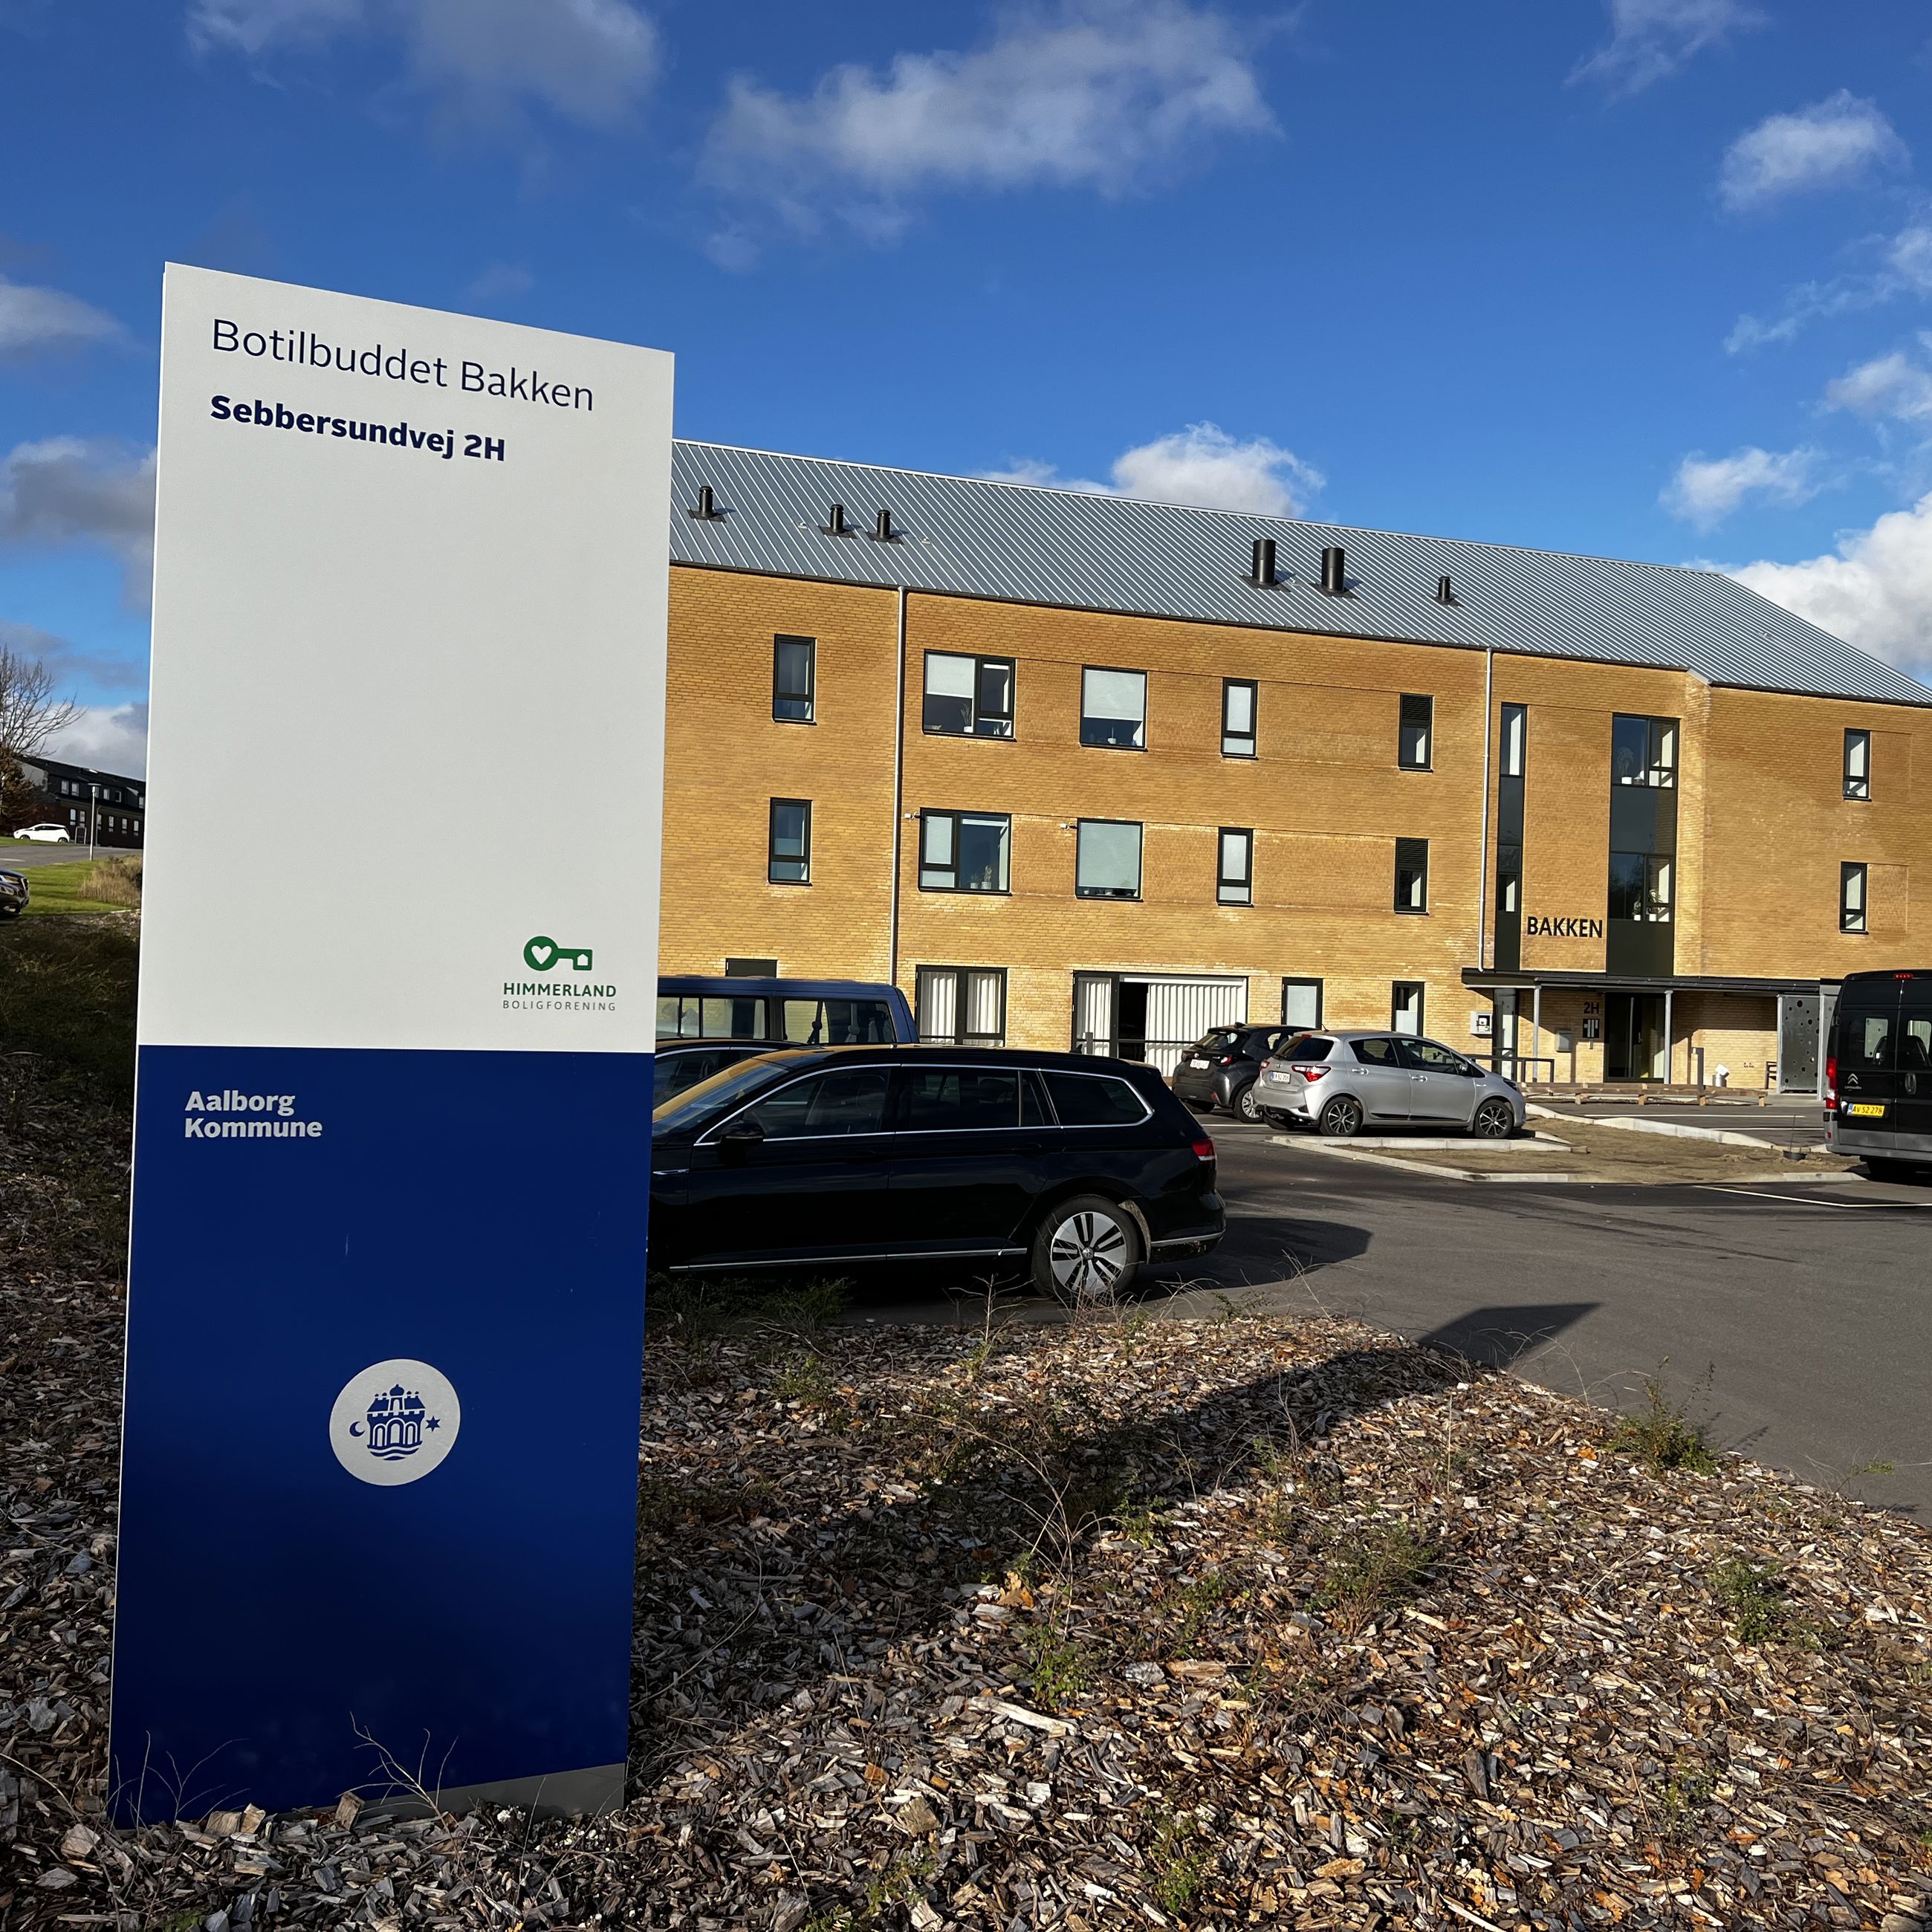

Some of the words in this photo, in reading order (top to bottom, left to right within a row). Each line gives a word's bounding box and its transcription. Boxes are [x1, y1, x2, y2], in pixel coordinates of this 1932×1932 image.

[213, 318, 448, 387] Botilbuddet
[461, 360, 593, 412] Bakken
[210, 395, 454, 460] Sebbersundvej
[464, 434, 505, 461] 2H
[1527, 915, 1603, 939] BAKKEN
[503, 982, 617, 997] HIMMERLAND
[502, 999, 615, 1011] BOLIGFORENING
[1583, 1001, 1600, 1014] 2H
[184, 1089, 296, 1117] Aalborg
[184, 1118, 322, 1138] Kommune
